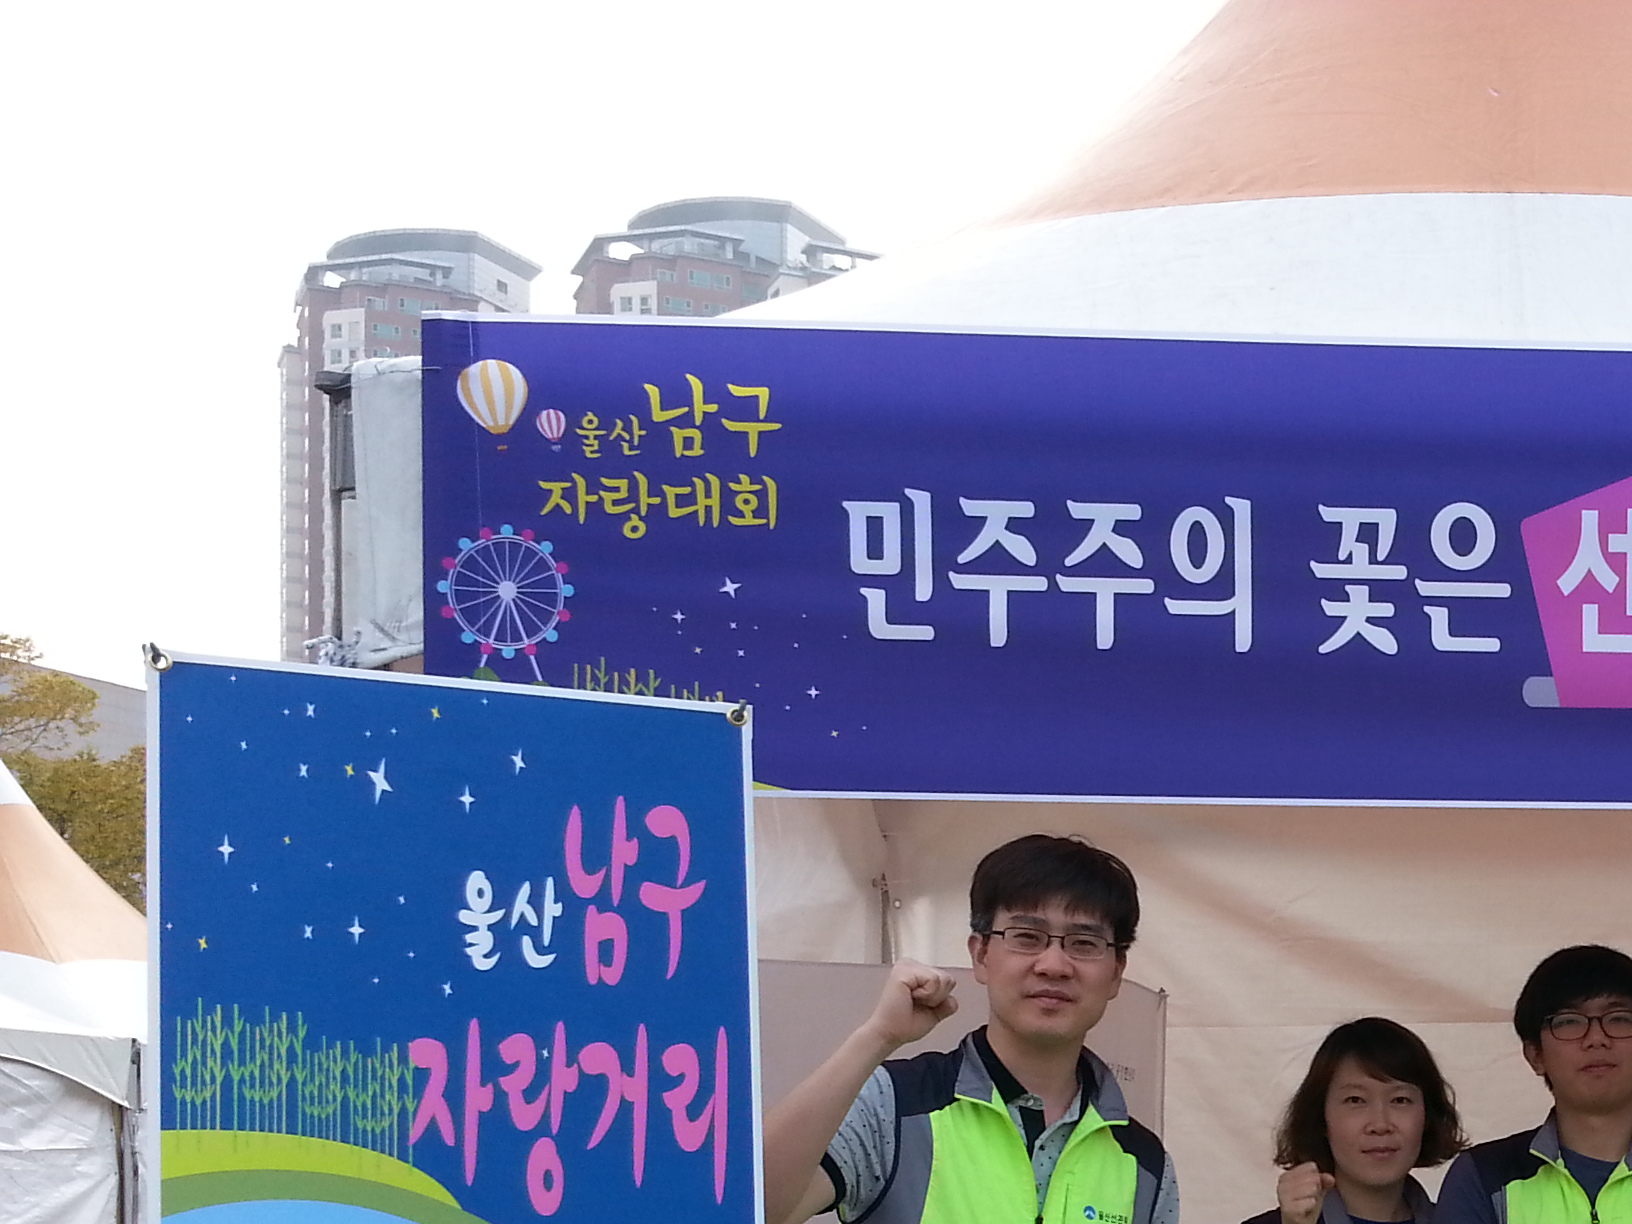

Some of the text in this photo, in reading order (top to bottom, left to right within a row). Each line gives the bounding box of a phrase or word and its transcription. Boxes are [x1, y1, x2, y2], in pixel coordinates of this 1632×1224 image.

[575, 373, 782, 458] 울산 남구
[538, 472, 779, 540] 자랑대회
[841, 487, 1253, 653] 민주주의
[1309, 501, 1512, 656] 꽃은
[458, 795, 707, 987] 울산 남구
[407, 1018, 729, 1217] 자랑거리
